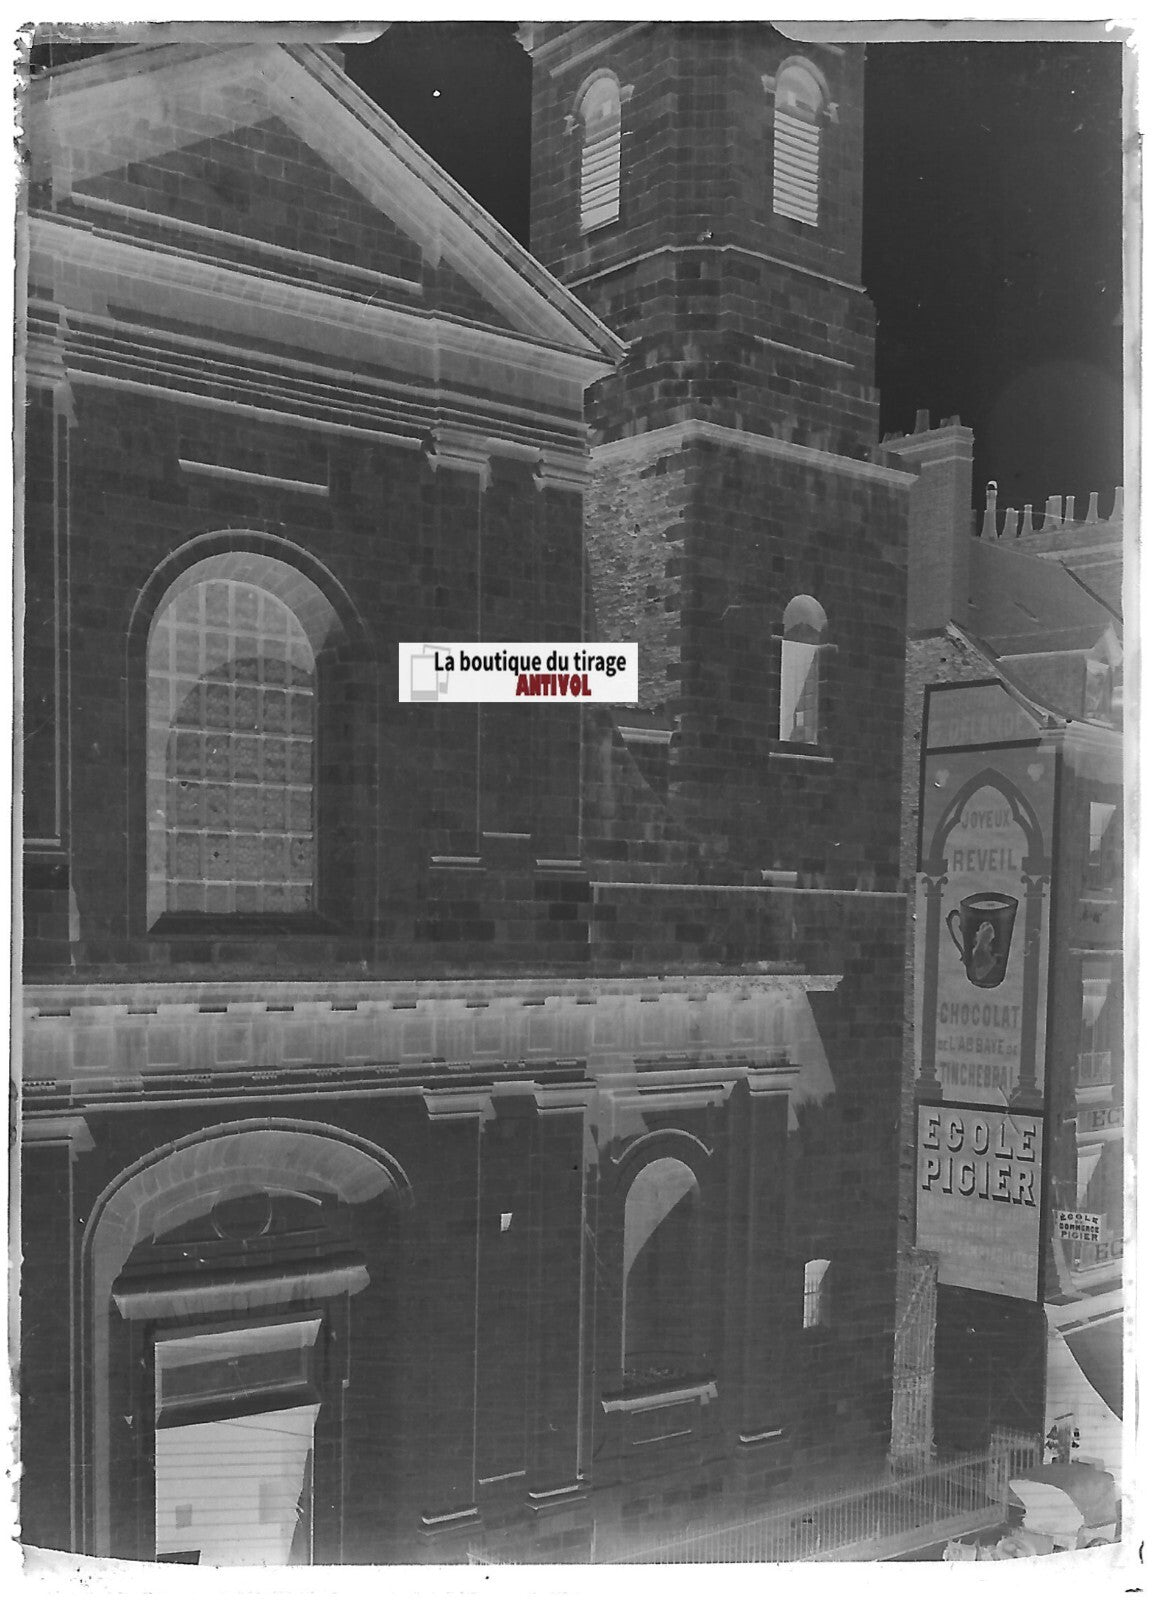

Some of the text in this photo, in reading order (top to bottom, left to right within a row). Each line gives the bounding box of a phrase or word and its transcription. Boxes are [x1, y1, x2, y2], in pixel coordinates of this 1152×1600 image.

[961, 809, 1011, 829] JOYEUX
[952, 848, 1018, 873] REVEIL
[938, 1002, 1021, 1029] CHOCOLAT
[923, 1111, 1037, 1163] ECOLE
[922, 1156, 1037, 1208] PIGIER
[1059, 1222, 1100, 1234] COMMERCE
[1060, 1213, 1099, 1225] ECOLE
[1060, 1230, 1099, 1242] PIGIER
